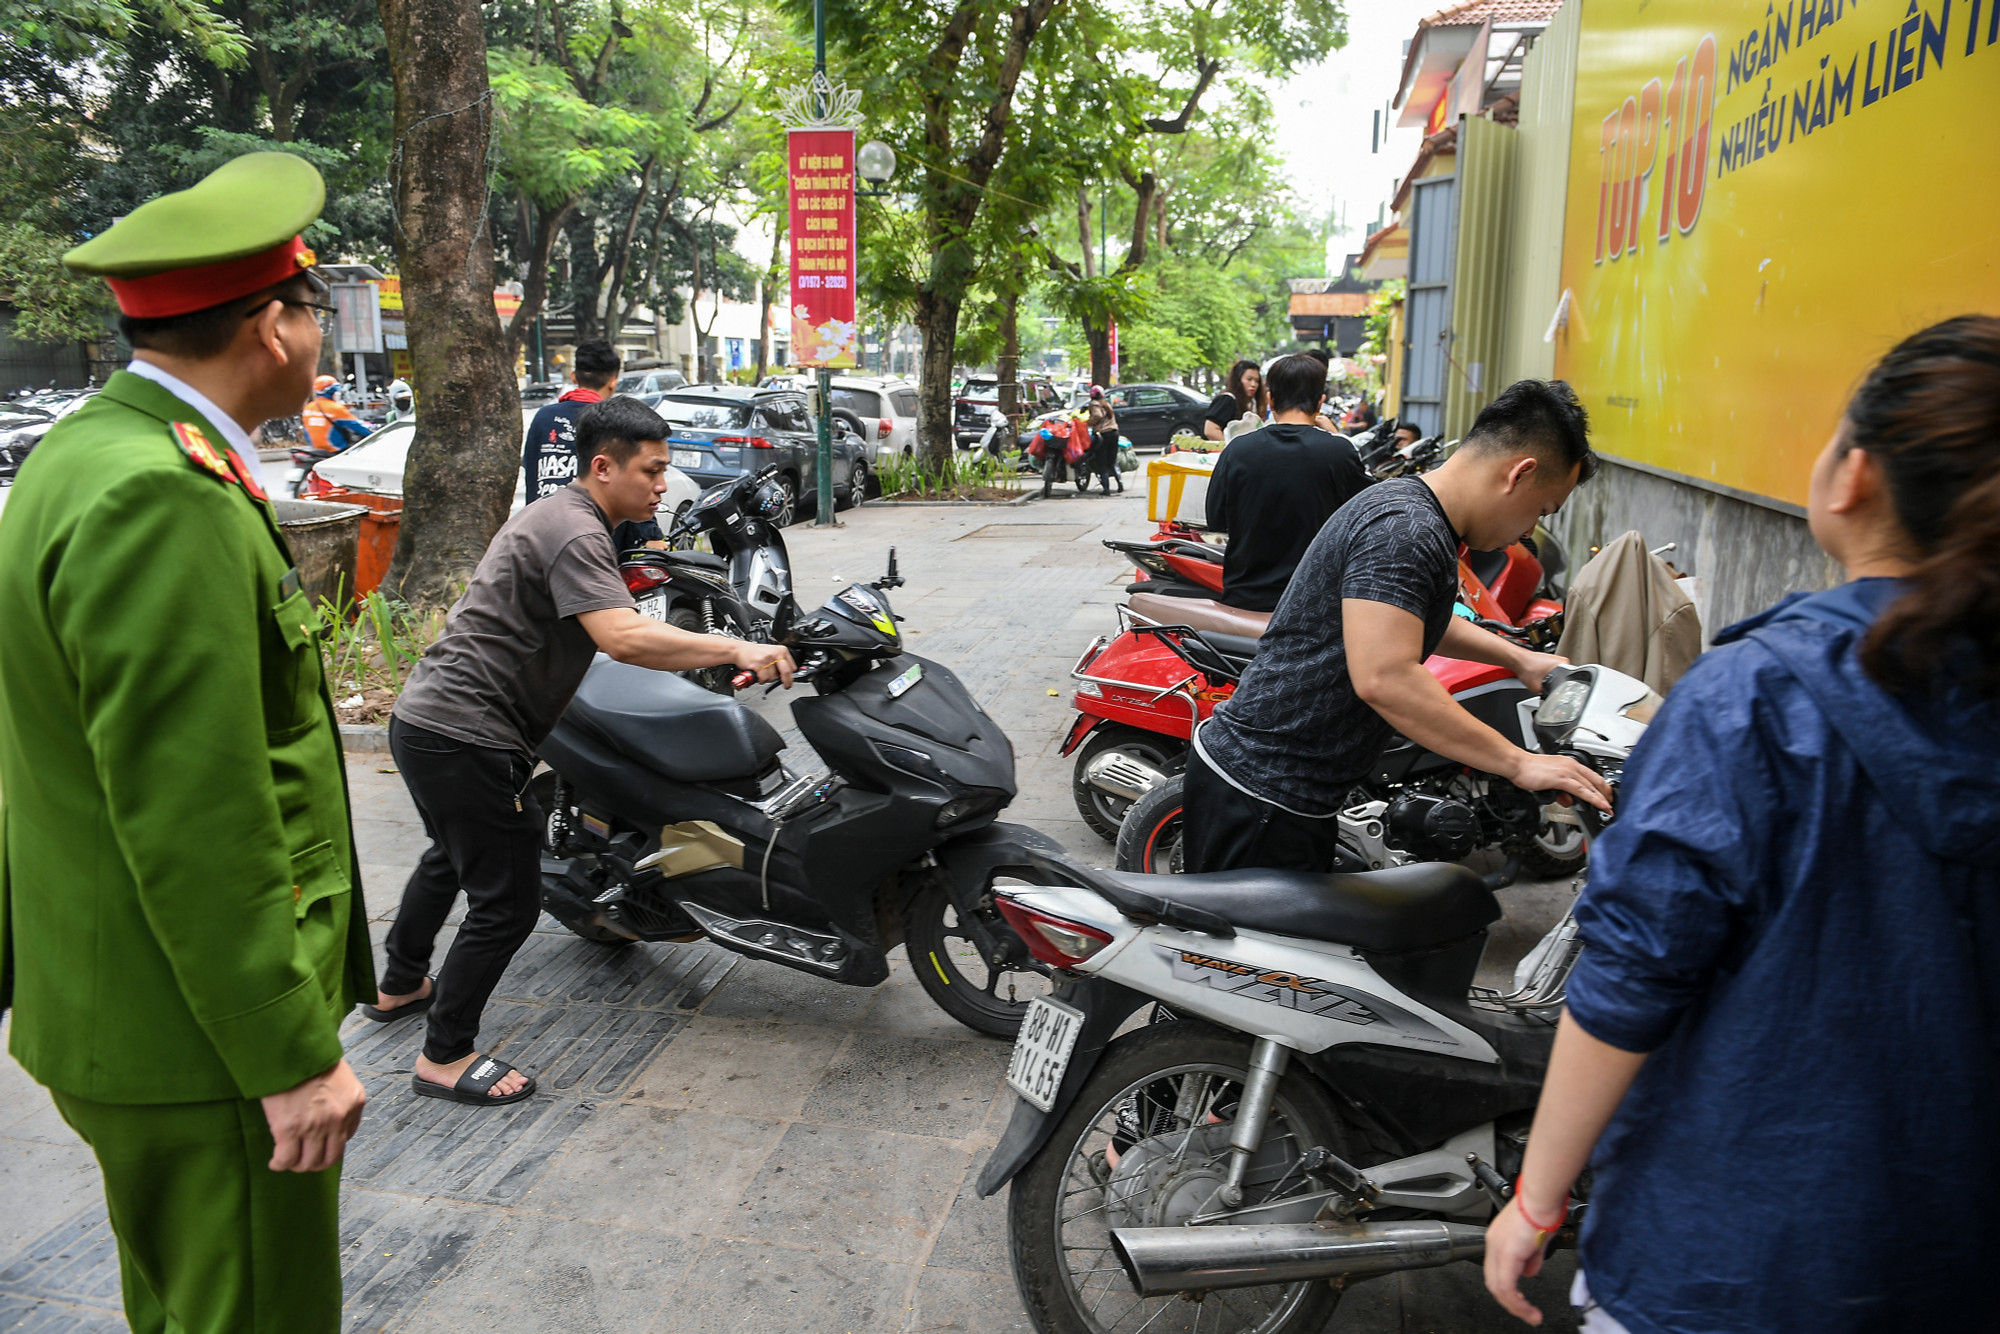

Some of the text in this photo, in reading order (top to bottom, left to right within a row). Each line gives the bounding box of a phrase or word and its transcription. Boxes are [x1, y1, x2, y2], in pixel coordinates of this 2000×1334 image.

[1717, 77, 1787, 179] NHIỀU
[1788, 51, 1859, 144] NĂM
[1862, 0, 1950, 109] LIÊN
[1594, 32, 1718, 264] TOP 10
[537, 454, 578, 478] NASA
[1182, 953, 1252, 976] WAVE
